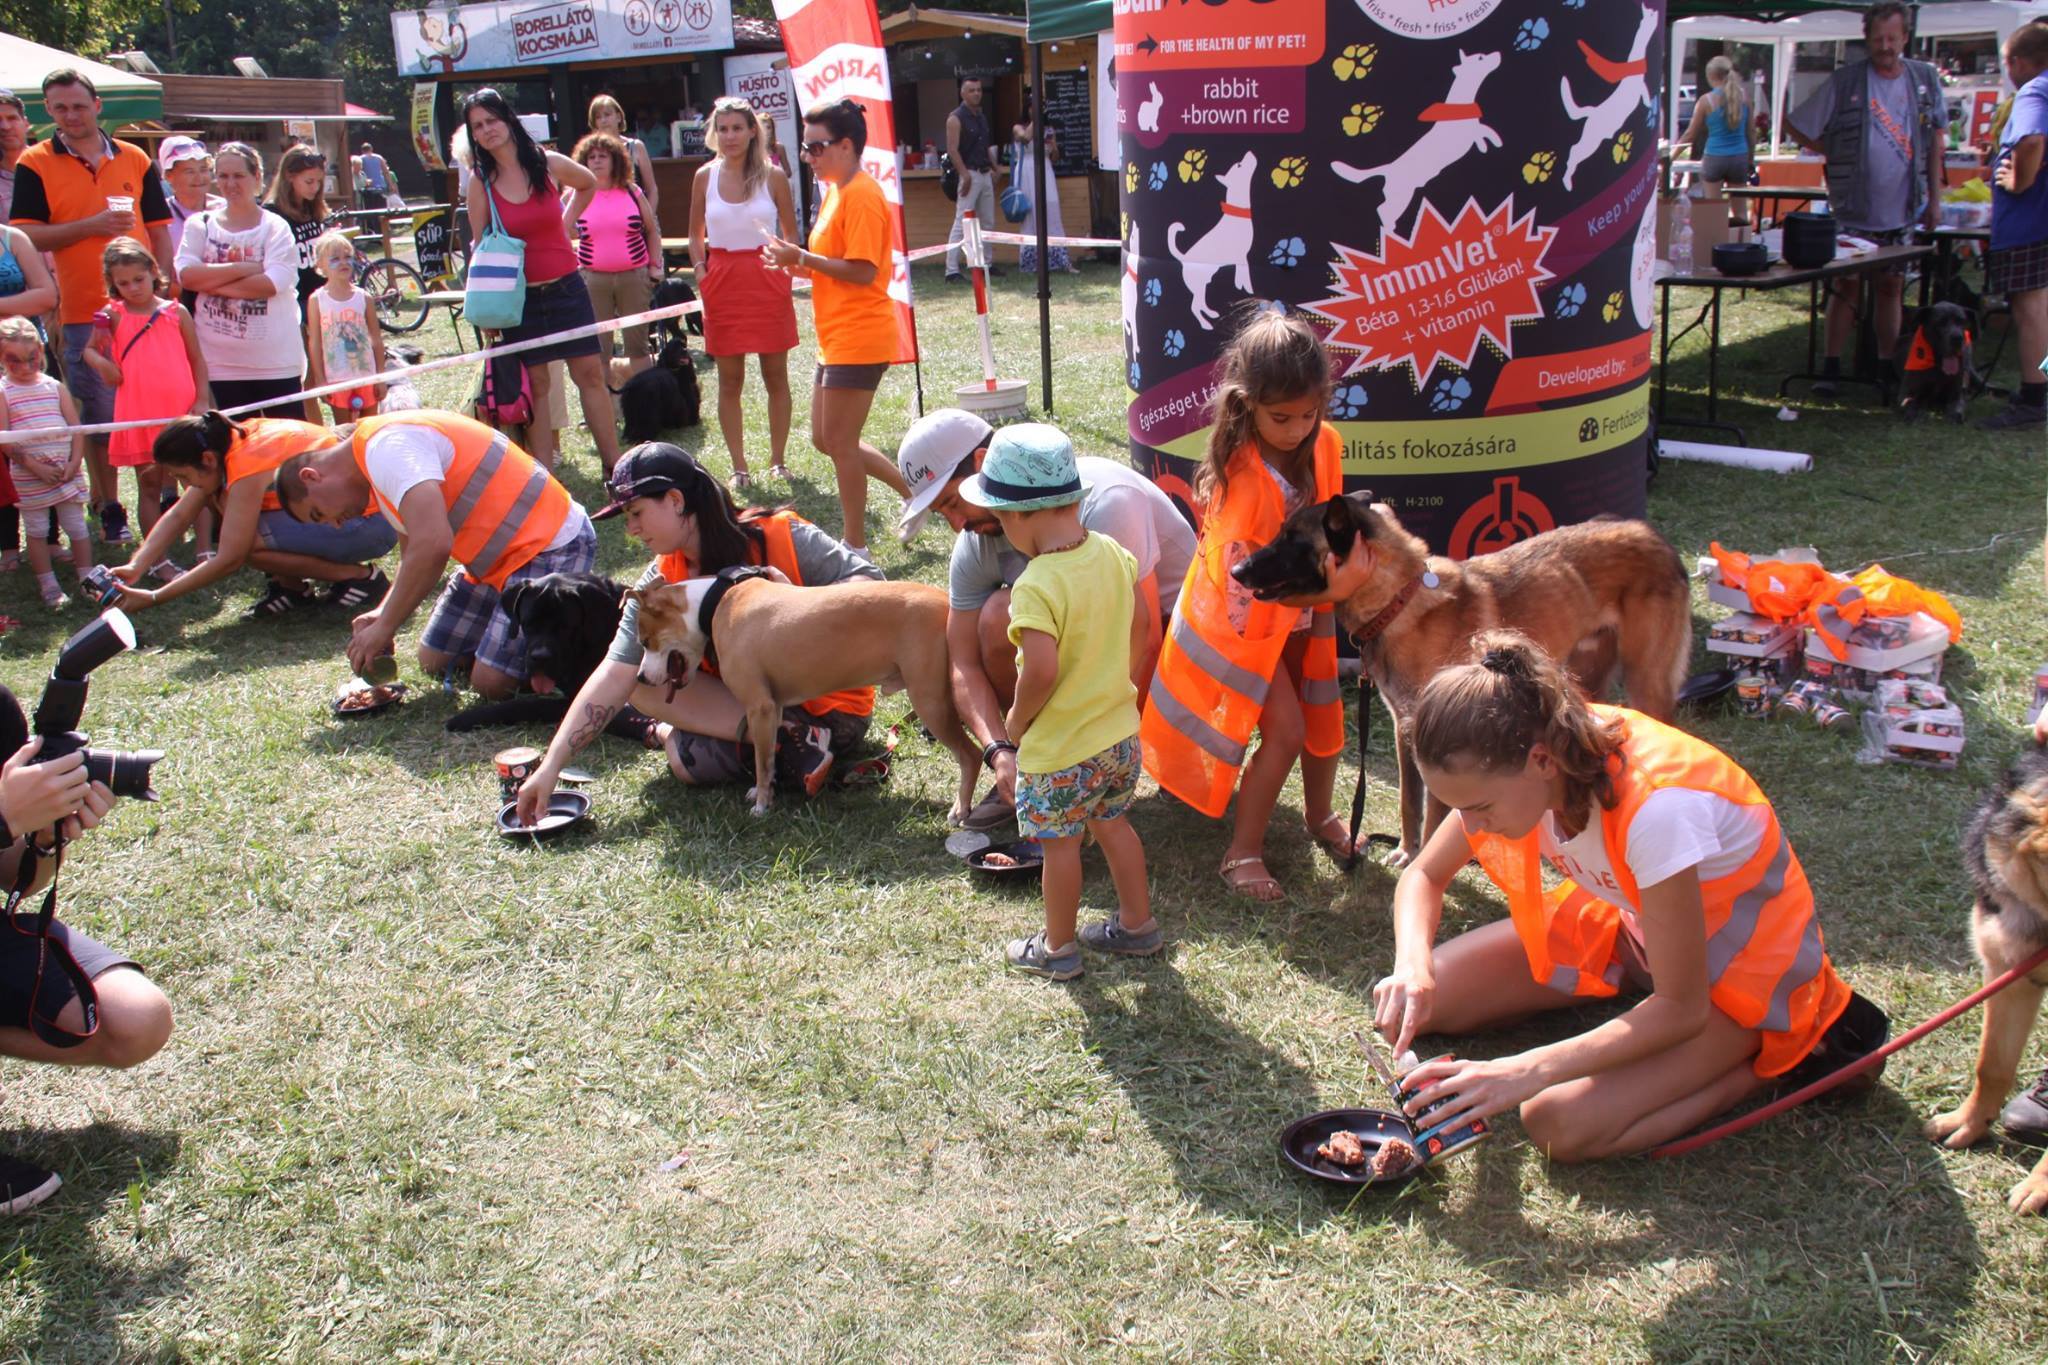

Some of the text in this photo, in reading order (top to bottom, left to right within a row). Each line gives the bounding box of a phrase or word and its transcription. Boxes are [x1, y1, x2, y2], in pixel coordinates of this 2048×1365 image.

[514, 5, 593, 37] BORELLÁTÓ
[1394, 17, 1422, 33] fresh
[1433, 22, 1457, 33] friss
[1465, 0, 1492, 23] fresh
[518, 27, 596, 56] KOCSMÁJA
[1160, 34, 1307, 54] FOR THE HEALTH OF MY PET!
[747, 91, 788, 110] ÖCCS
[1203, 77, 1259, 99] rabbit
[1181, 104, 1290, 125] +brown rice
[1587, 176, 1646, 237] Keep your
[1355, 257, 1525, 336] Béta 1,3-1,6 Glükán!
[1420, 300, 1496, 338] vitamin
[1538, 360, 1610, 389] Developed
[1611, 358, 1627, 377] by:
[1139, 391, 1200, 432] Egészséget
[1340, 435, 1517, 460] alitás fokozására
[1405, 496, 1444, 507] H-2100
